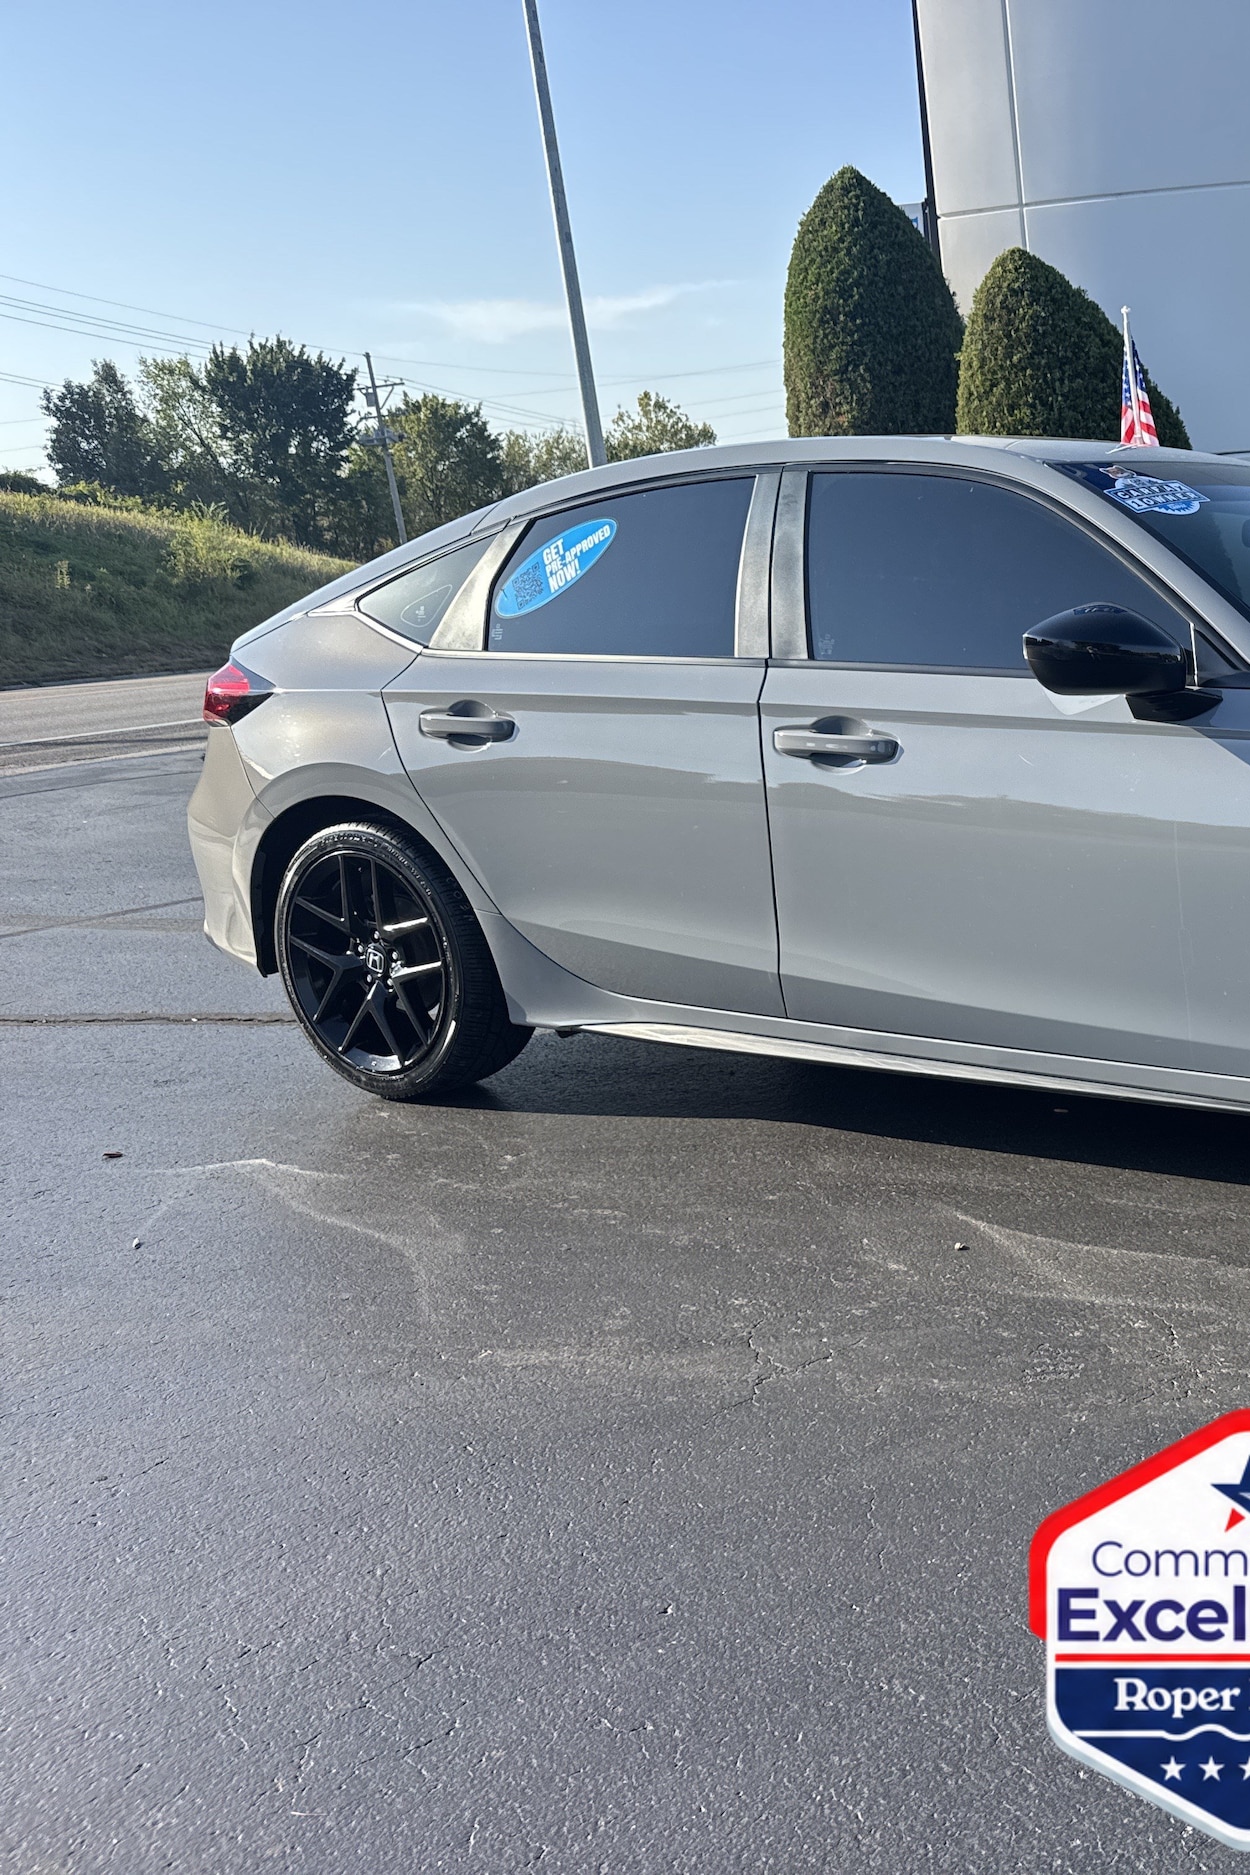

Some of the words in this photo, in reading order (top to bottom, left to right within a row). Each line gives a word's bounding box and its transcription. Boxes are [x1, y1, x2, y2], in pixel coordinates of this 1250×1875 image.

[1117, 483, 1190, 499] CARFAX
[542, 538, 564, 565] GET
[545, 524, 611, 577] PRE-APPROVED
[548, 558, 581, 593] NOW!
